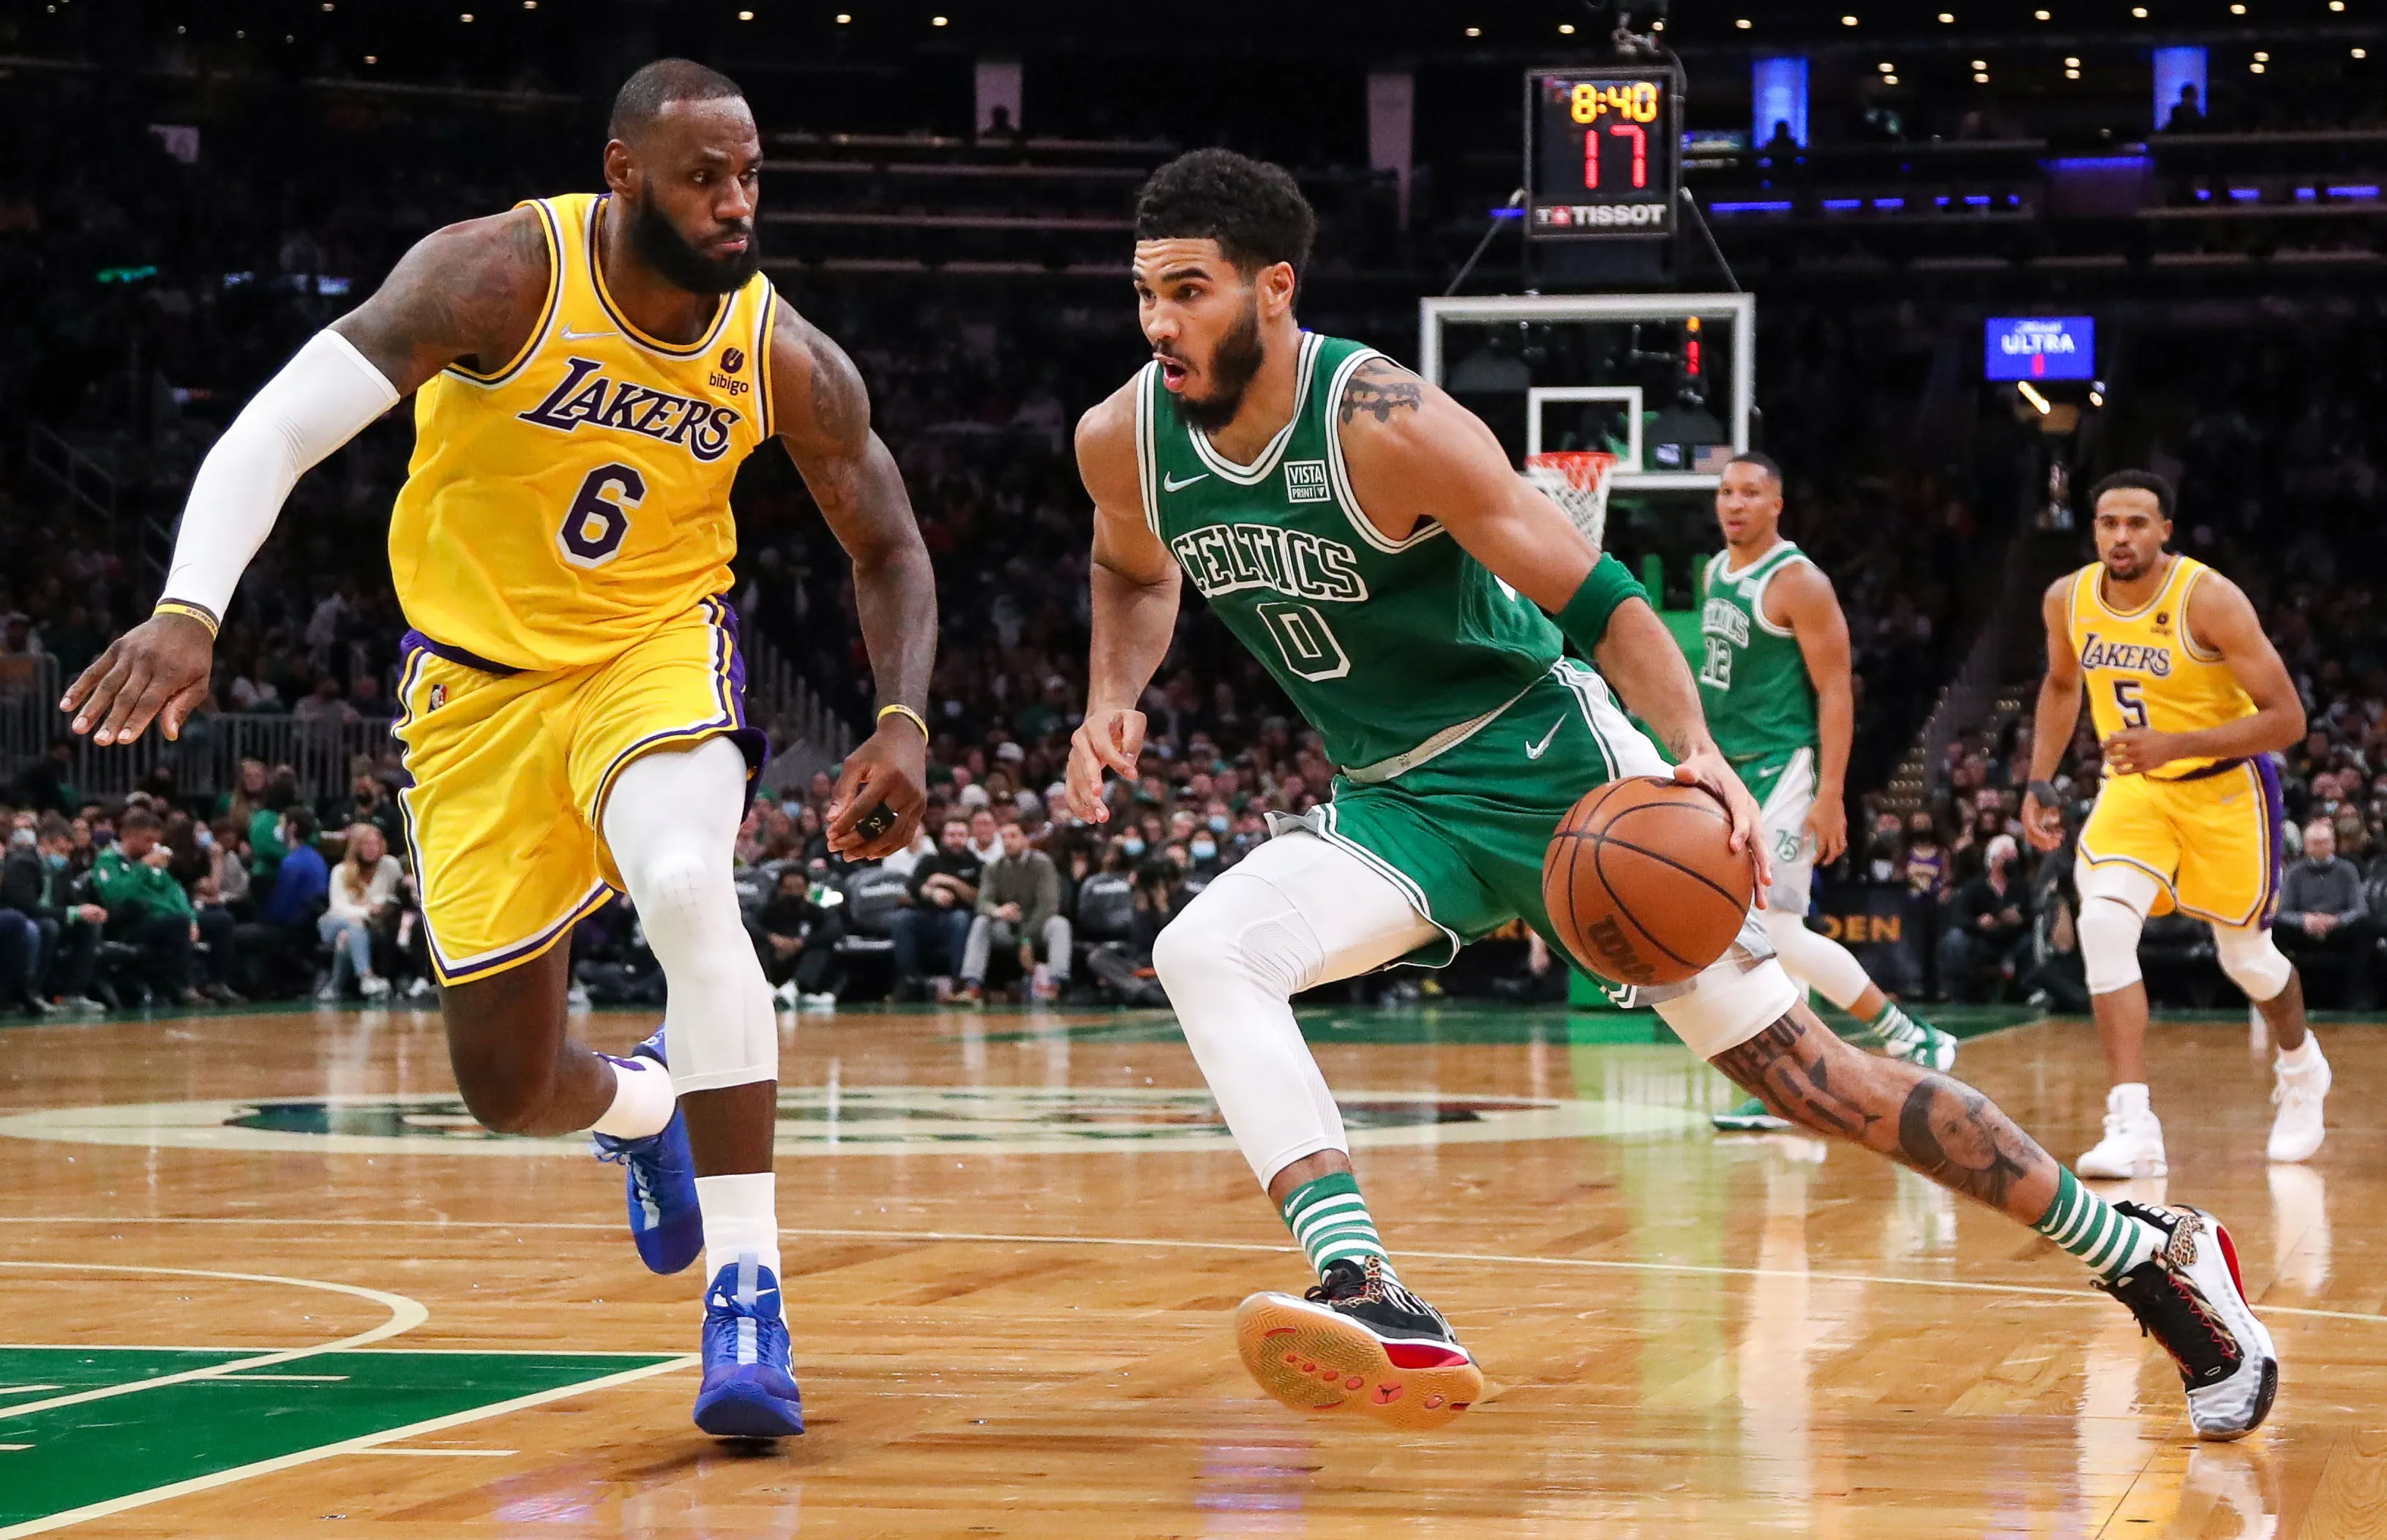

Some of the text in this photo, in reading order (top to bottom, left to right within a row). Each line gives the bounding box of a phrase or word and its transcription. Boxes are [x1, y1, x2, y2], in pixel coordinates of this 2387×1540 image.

[1571, 82, 1658, 124] 8:40
[1585, 124, 1646, 189] 17
[1572, 203, 1667, 226] TISSOT
[2001, 333, 2075, 355] ULTRA
[708, 372, 749, 395] bibigo
[514, 356, 741, 463] LAKERS
[1289, 465, 1324, 484] VISTA
[1292, 487, 1313, 499] PRINT
[555, 462, 648, 569] 6
[1171, 523, 1369, 602] CELTICS
[1256, 601, 1351, 682] 0
[2080, 631, 2172, 680] LAKERS
[2112, 679, 2151, 729] 5
